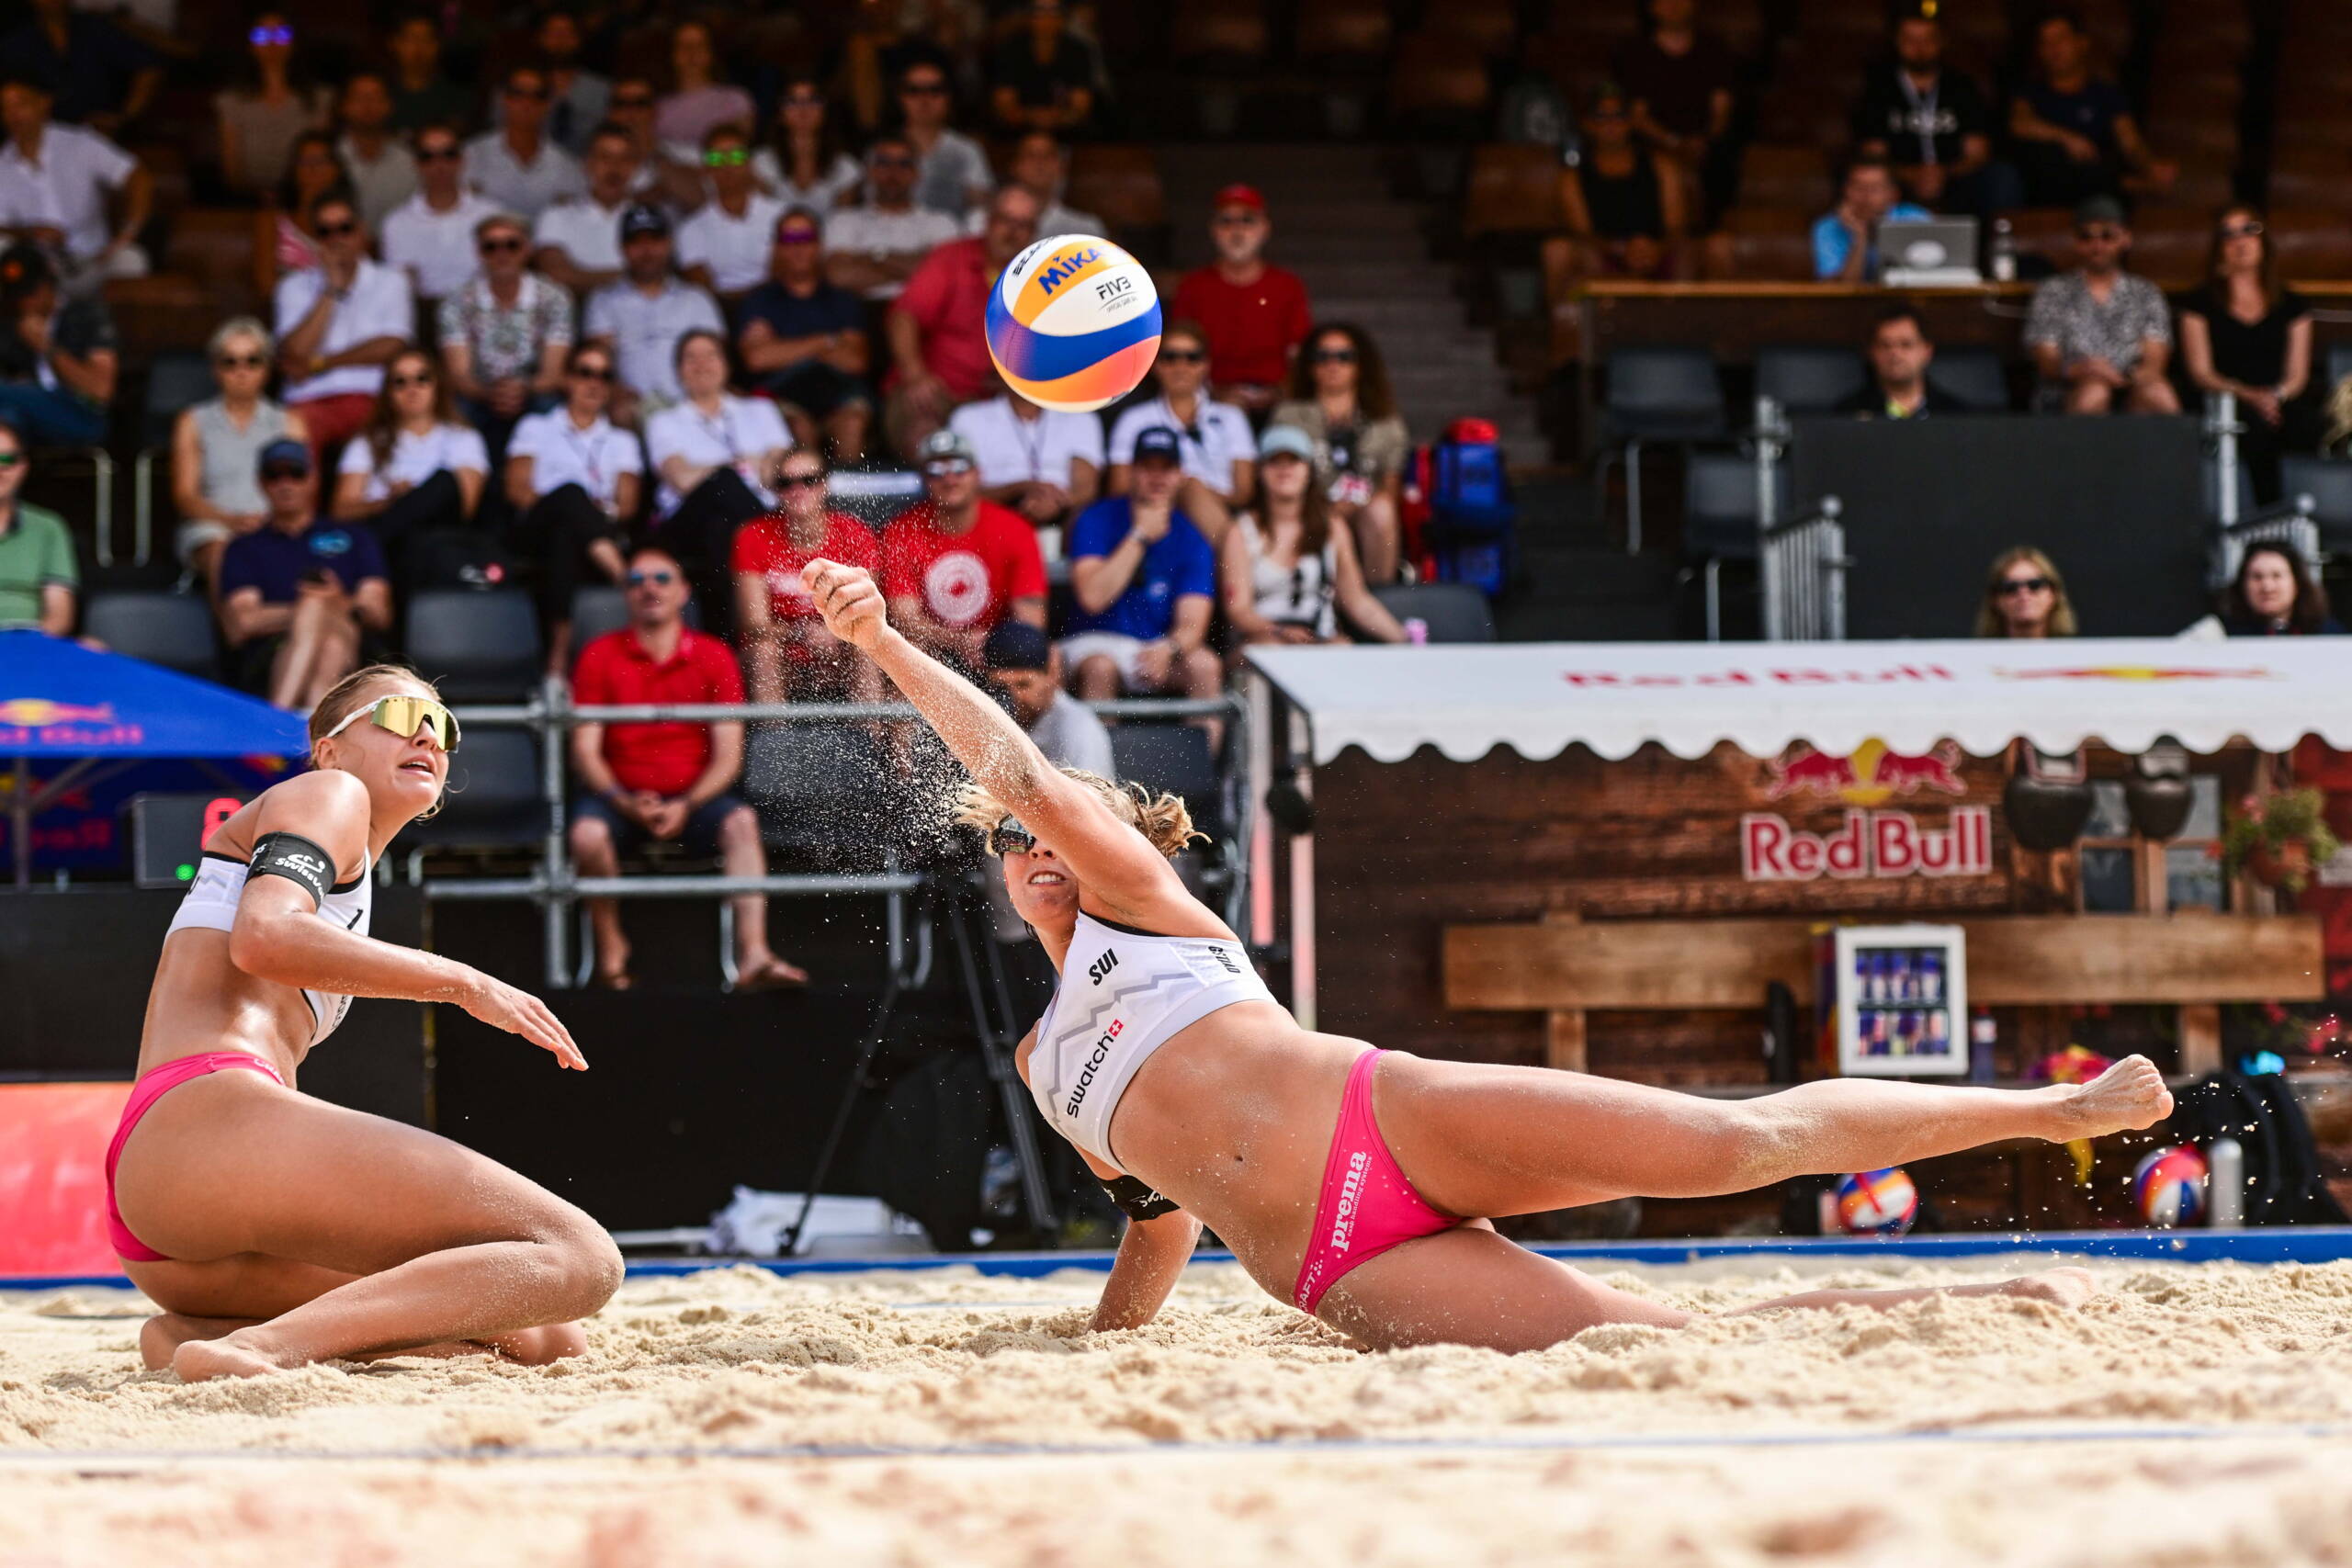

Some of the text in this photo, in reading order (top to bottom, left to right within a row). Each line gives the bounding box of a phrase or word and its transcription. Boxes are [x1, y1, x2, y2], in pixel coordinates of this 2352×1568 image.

[1096, 276, 1132, 299] FIVB
[1744, 807, 1990, 879] Red Bull
[1088, 947, 1120, 987] SUI
[1067, 1031, 1114, 1119] swatch
[1330, 1151, 1367, 1253] prema
